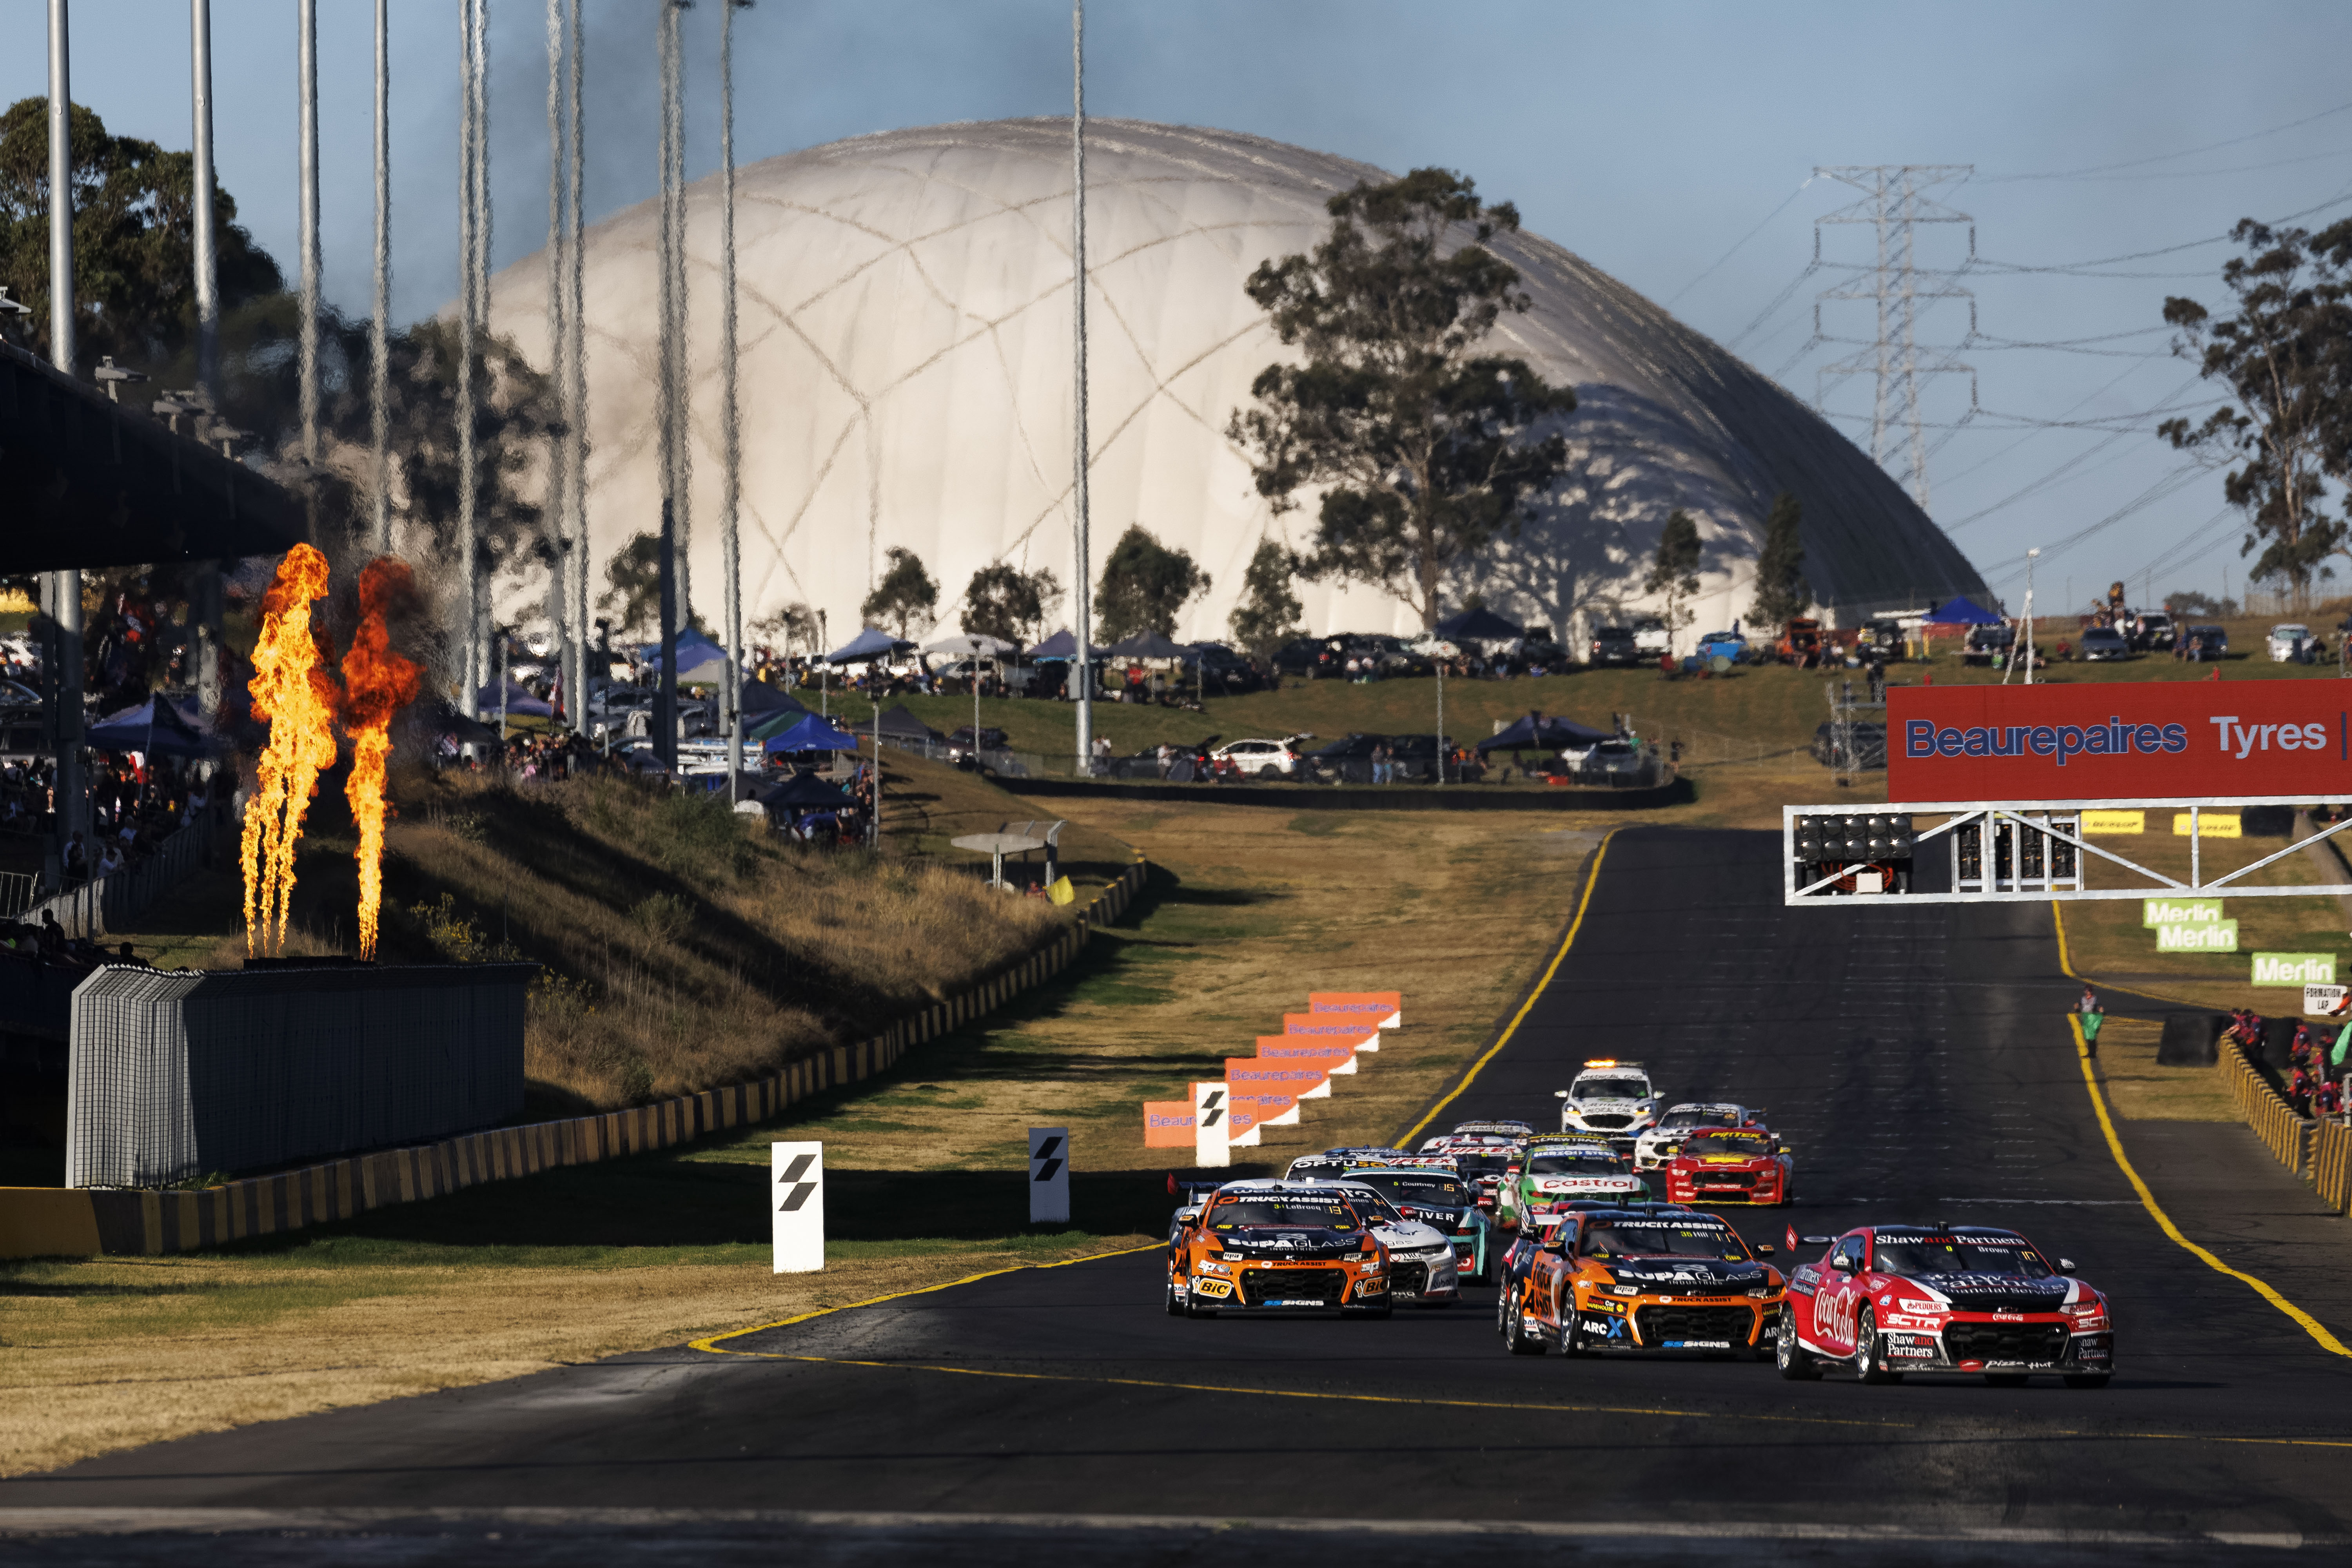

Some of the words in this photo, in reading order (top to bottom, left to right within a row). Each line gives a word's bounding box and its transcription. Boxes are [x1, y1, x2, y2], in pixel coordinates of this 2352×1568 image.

[1905, 716, 2187, 766] Beaurepaires
[2209, 716, 2327, 759] Tyres
[2147, 902, 2219, 923] Merlin
[2160, 925, 2234, 947] Merlin
[2255, 958, 2332, 982] Merlin
[1314, 1002, 1394, 1015] Beaurepaires
[2317, 1000, 2328, 1010] LAP
[1288, 1023, 1372, 1036] Beaurepaires
[1261, 1046, 1350, 1058] Beaurepaires
[1230, 1069, 1323, 1082] Beaurepaires
[1544, 1179, 1633, 1190] Castrol
[1373, 1198, 1387, 1207] 14
[1670, 1222, 1725, 1230] ASSIST
[1955, 1235, 2025, 1245] Partners
[1977, 1246, 2009, 1254] Brown
[2022, 1251, 2038, 1261] 10
[1201, 1282, 1229, 1294] BiC
[2010, 1286, 2067, 1295] Services
[1587, 1303, 1614, 1313] WAREHOUSE
[1915, 1302, 1942, 1310] PEDDERS
[1886, 1313, 1941, 1328] SCTR
[1887, 1332, 1915, 1345] Shaw
[1887, 1343, 1933, 1357] Partners
[2078, 1348, 2108, 1359] Partners
[2027, 1361, 2054, 1370] Hut
